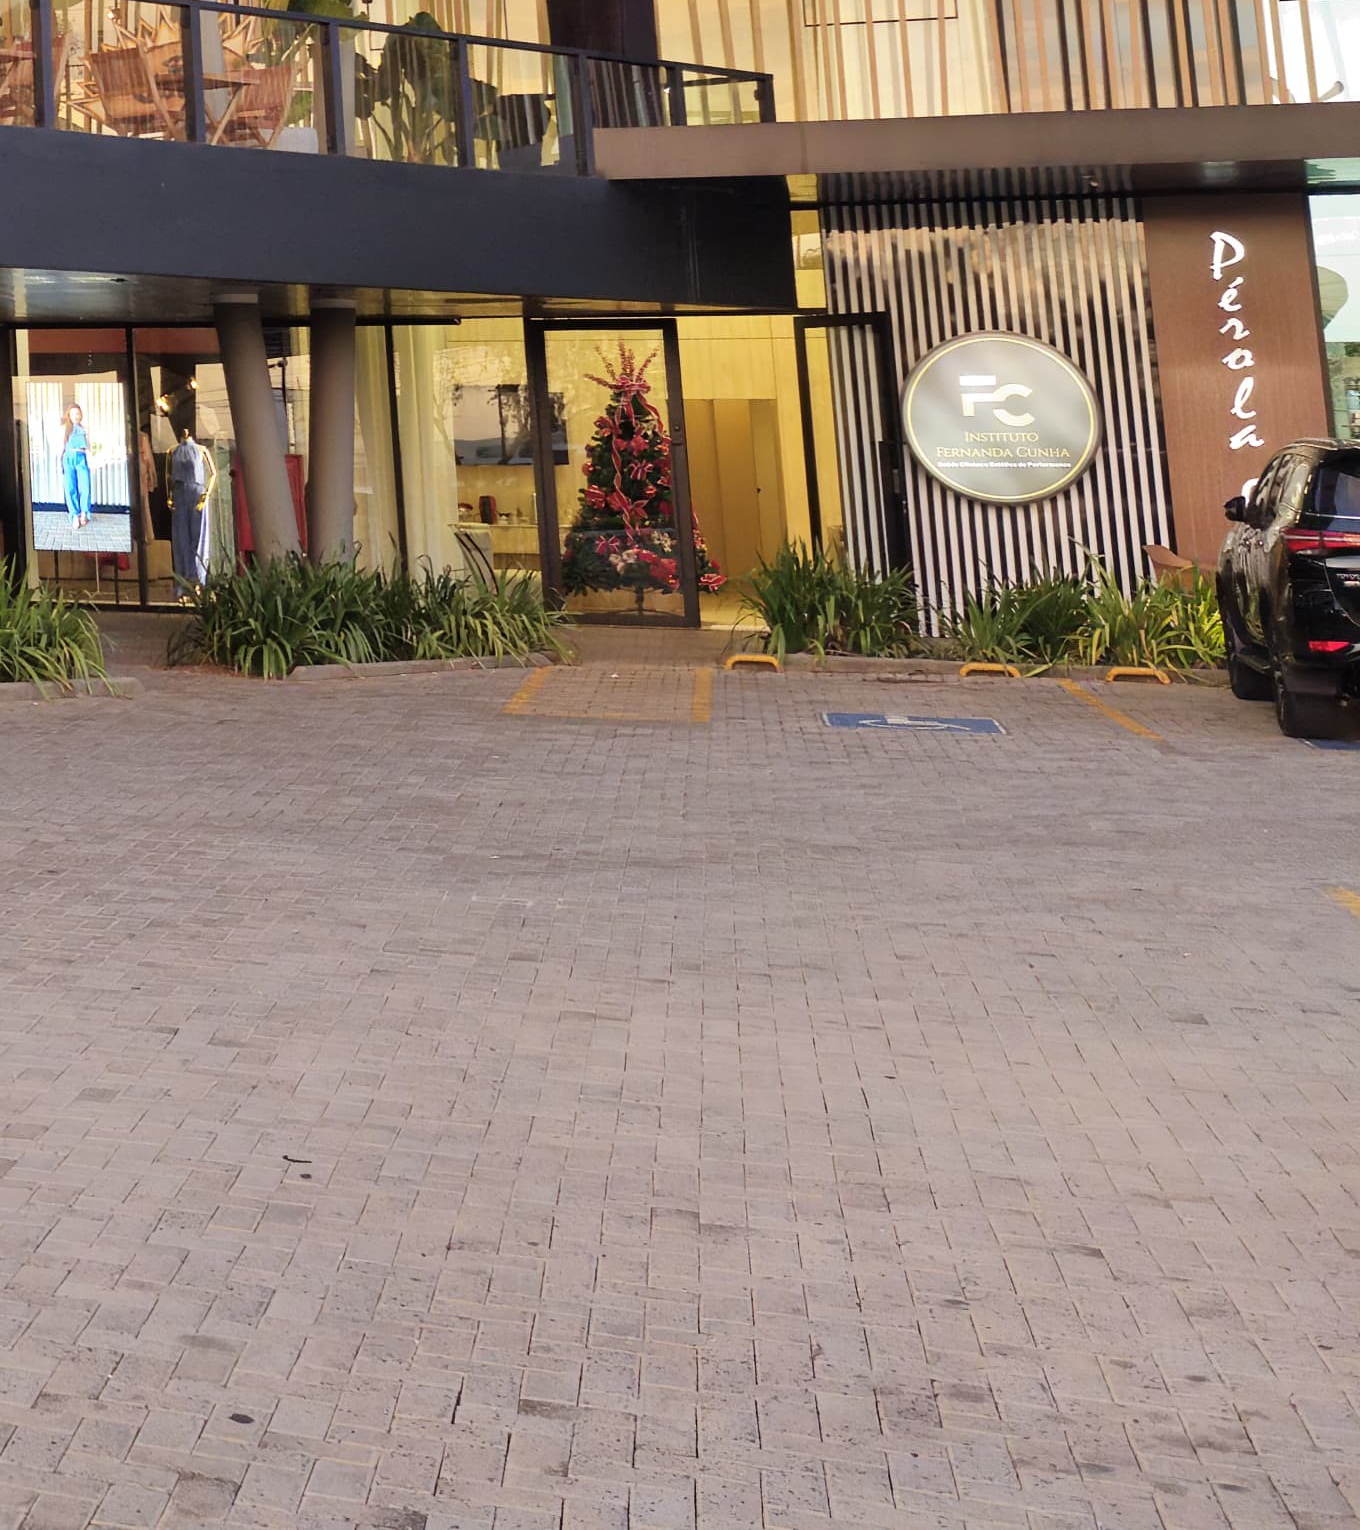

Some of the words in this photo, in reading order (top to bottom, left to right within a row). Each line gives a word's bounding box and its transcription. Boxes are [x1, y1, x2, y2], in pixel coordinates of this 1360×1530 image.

[1209, 230, 1265, 451] Pérola
[958, 374, 1036, 428] FC
[936, 446, 1013, 459] FERNANDA
[1016, 446, 1071, 459] CUNHA
[964, 431, 1039, 443] INSTITUTO
